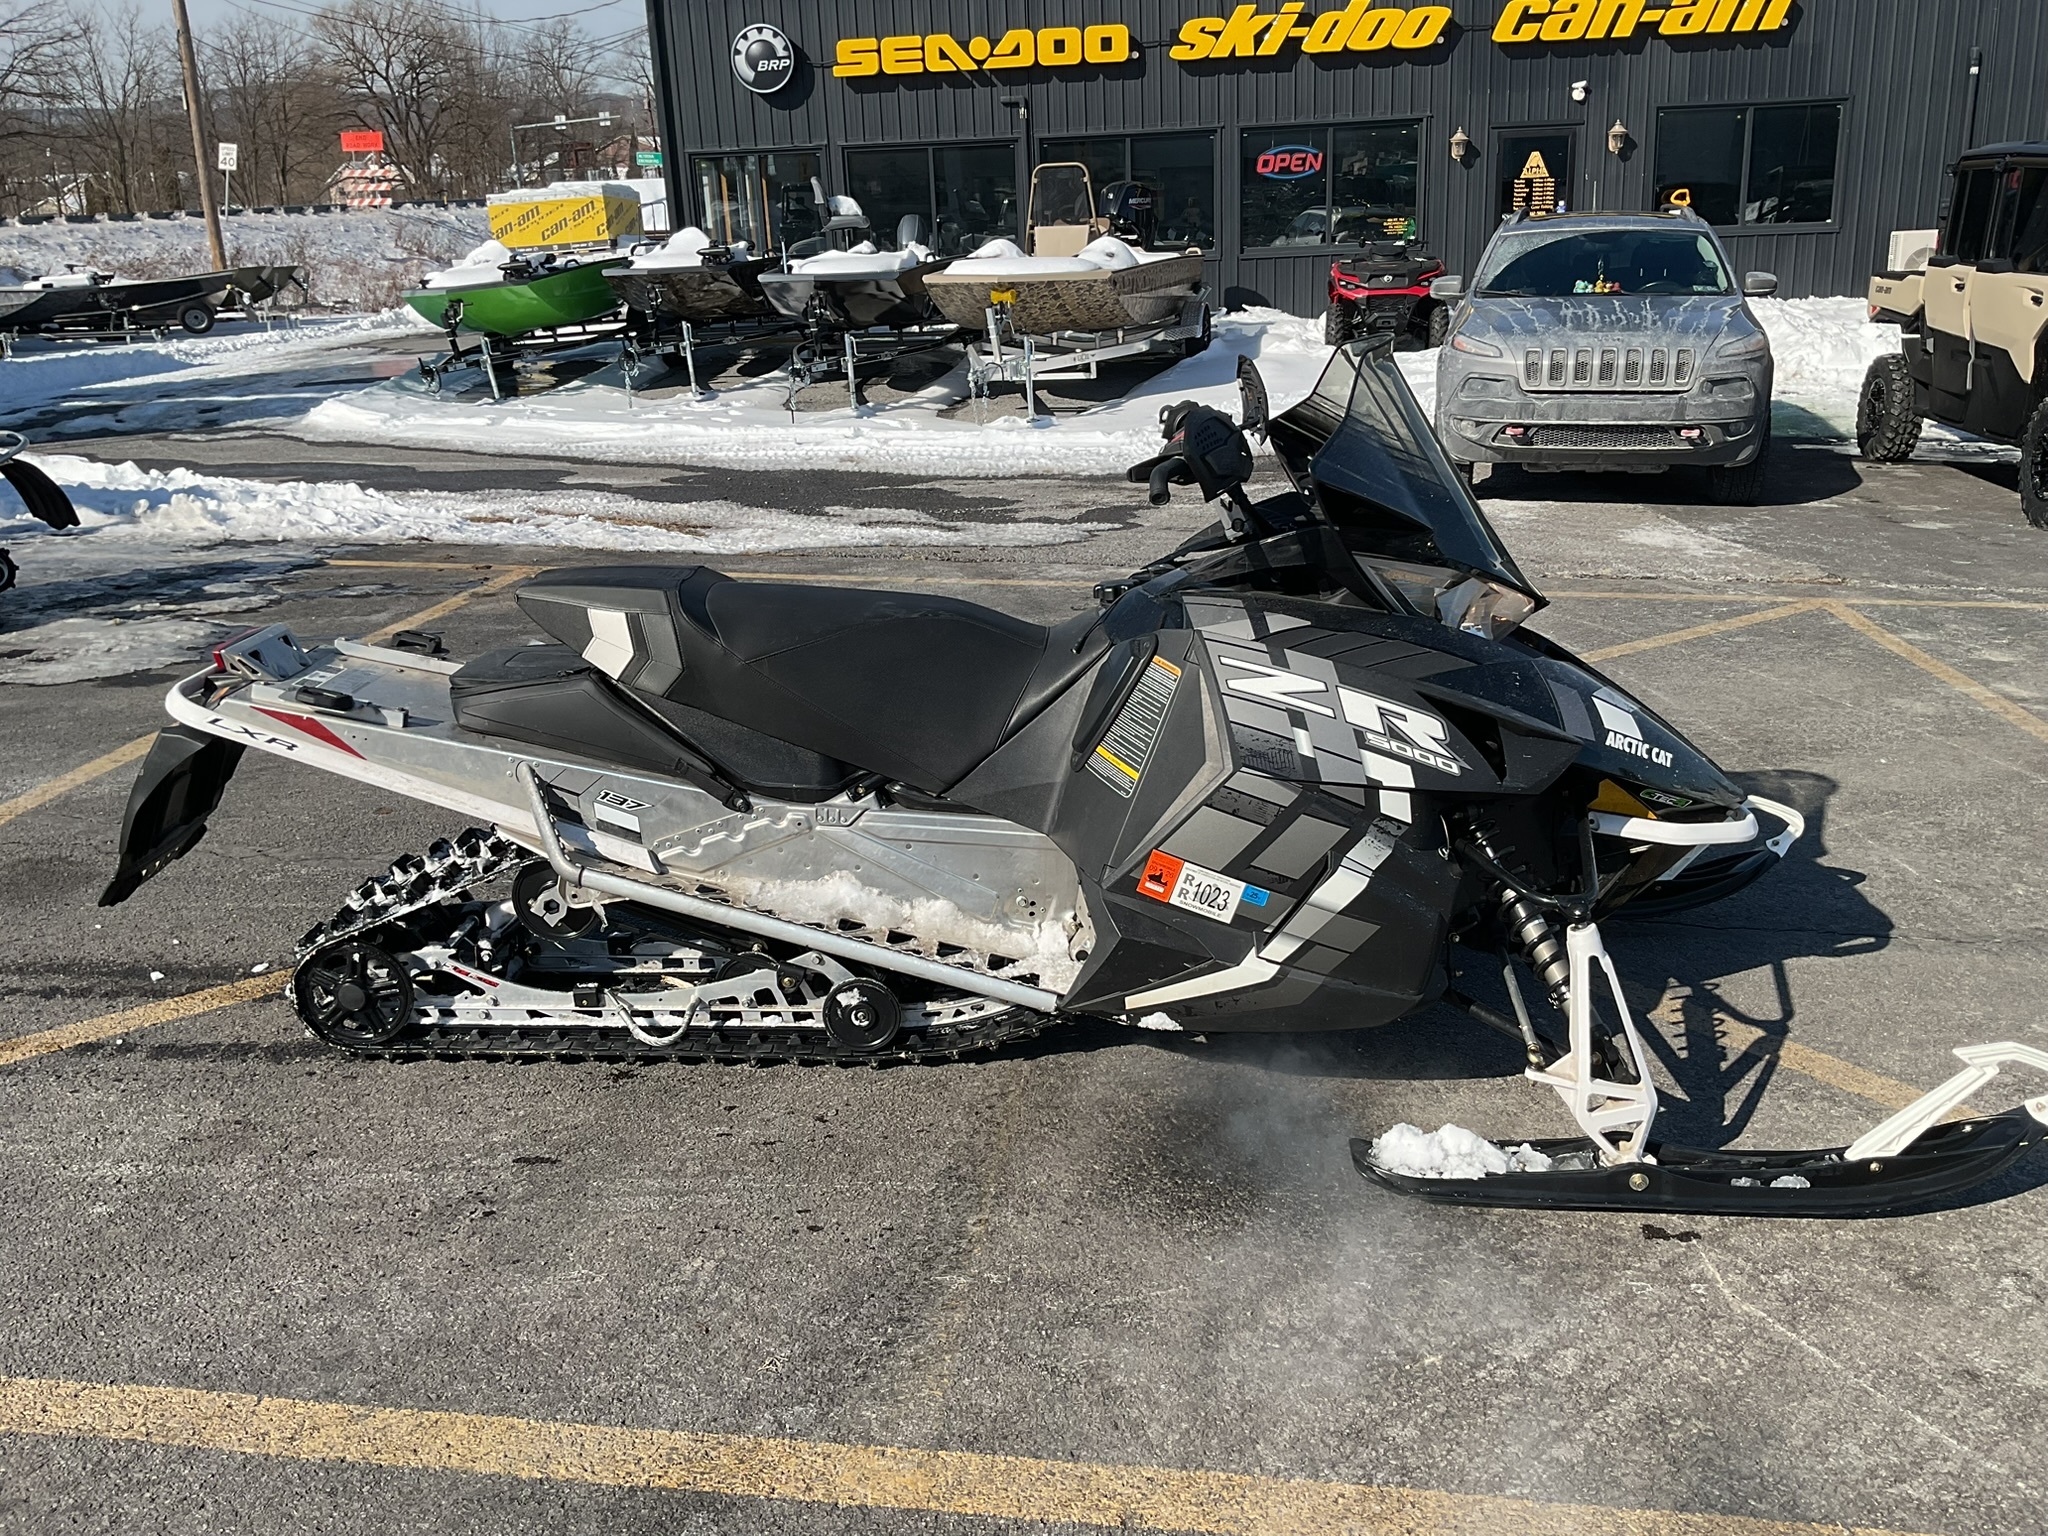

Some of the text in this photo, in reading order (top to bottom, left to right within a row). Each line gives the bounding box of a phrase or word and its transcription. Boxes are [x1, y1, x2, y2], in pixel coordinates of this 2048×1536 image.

[1491, 0, 1789, 42] can-am
[757, 58, 791, 71] BRP
[220, 156, 235, 167] 40
[1256, 152, 1323, 173] OPEN
[1128, 197, 1152, 205] MERCUR
[541, 199, 595, 242] can-am
[207, 718, 299, 751] LXR
[1363, 729, 1462, 777] 5000
[1605, 730, 1673, 768] ARCTIC CAT
[596, 789, 654, 811] 137
[1183, 873, 1195, 887] R
[1177, 887, 1190, 901] R
[1192, 881, 1231, 912] 1023
[1179, 899, 1222, 918] SNOWMOBILE
